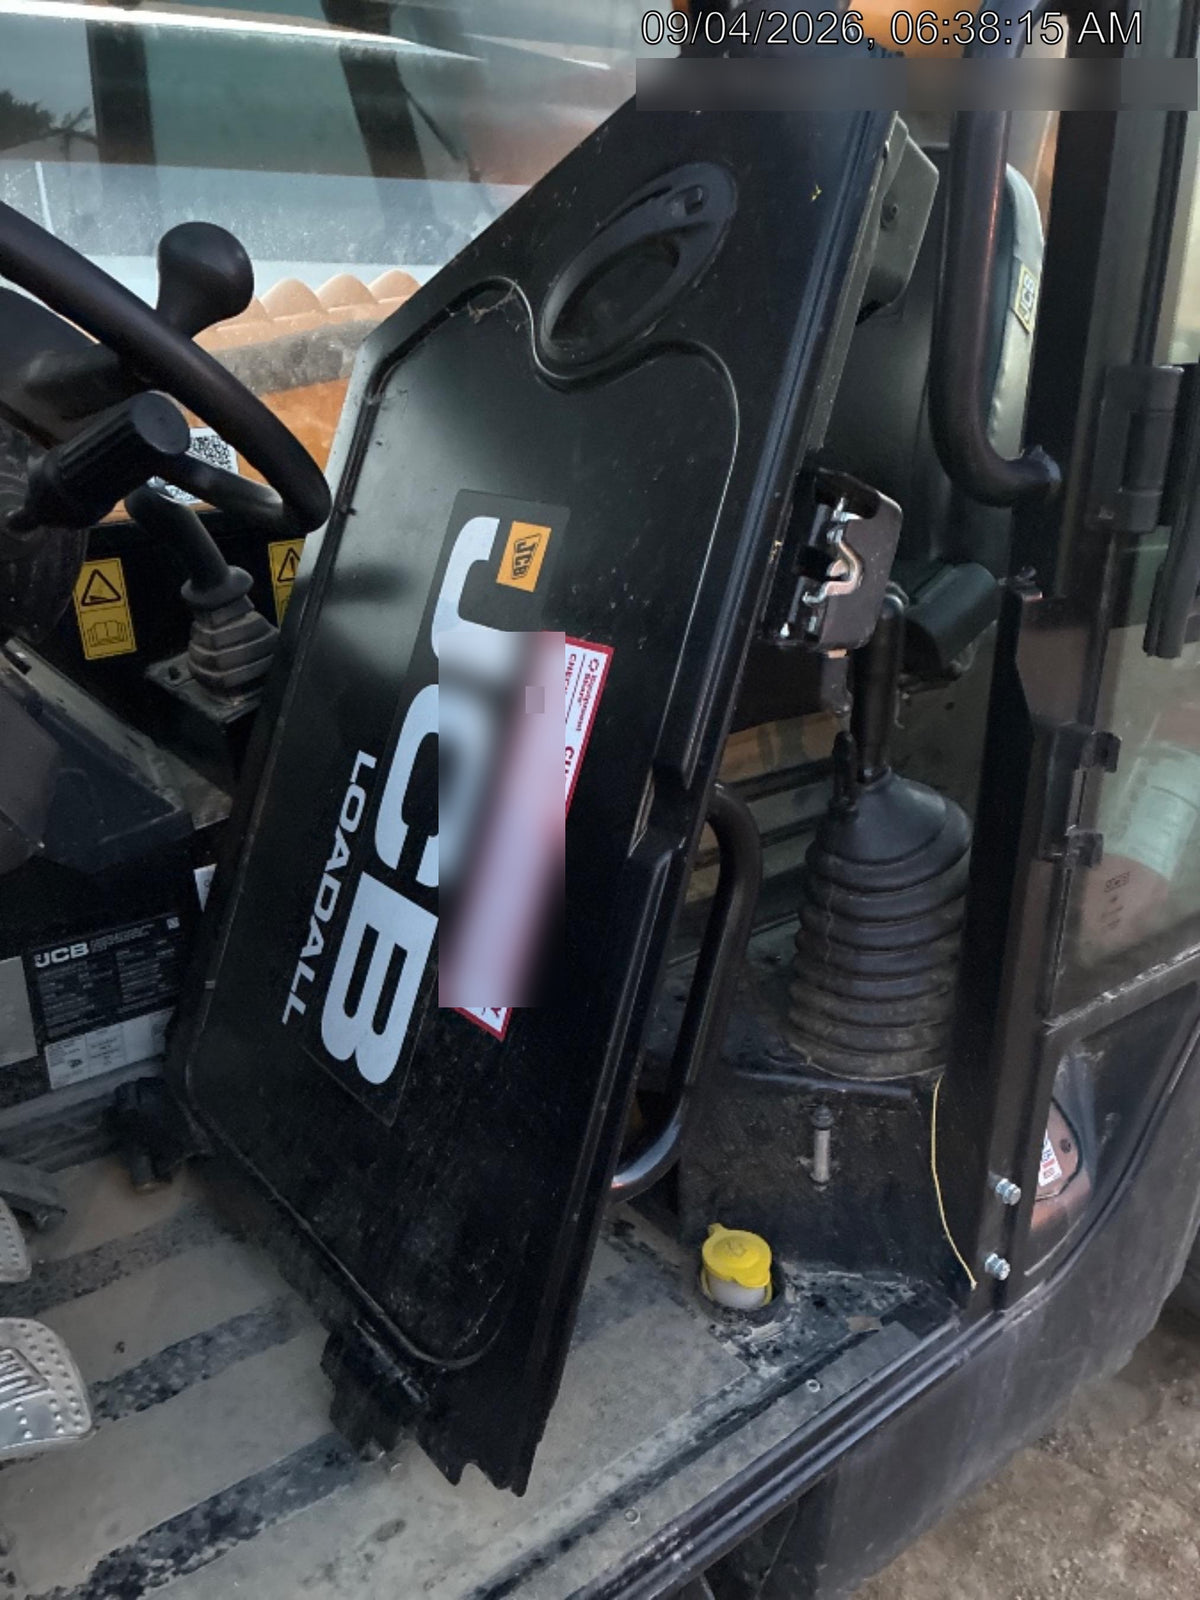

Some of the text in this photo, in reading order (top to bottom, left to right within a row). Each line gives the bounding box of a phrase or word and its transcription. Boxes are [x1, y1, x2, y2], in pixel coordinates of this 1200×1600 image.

[512, 536, 540, 577] JCB
[282, 750, 377, 1024] LOADALL
[34, 943, 89, 968] JCB
